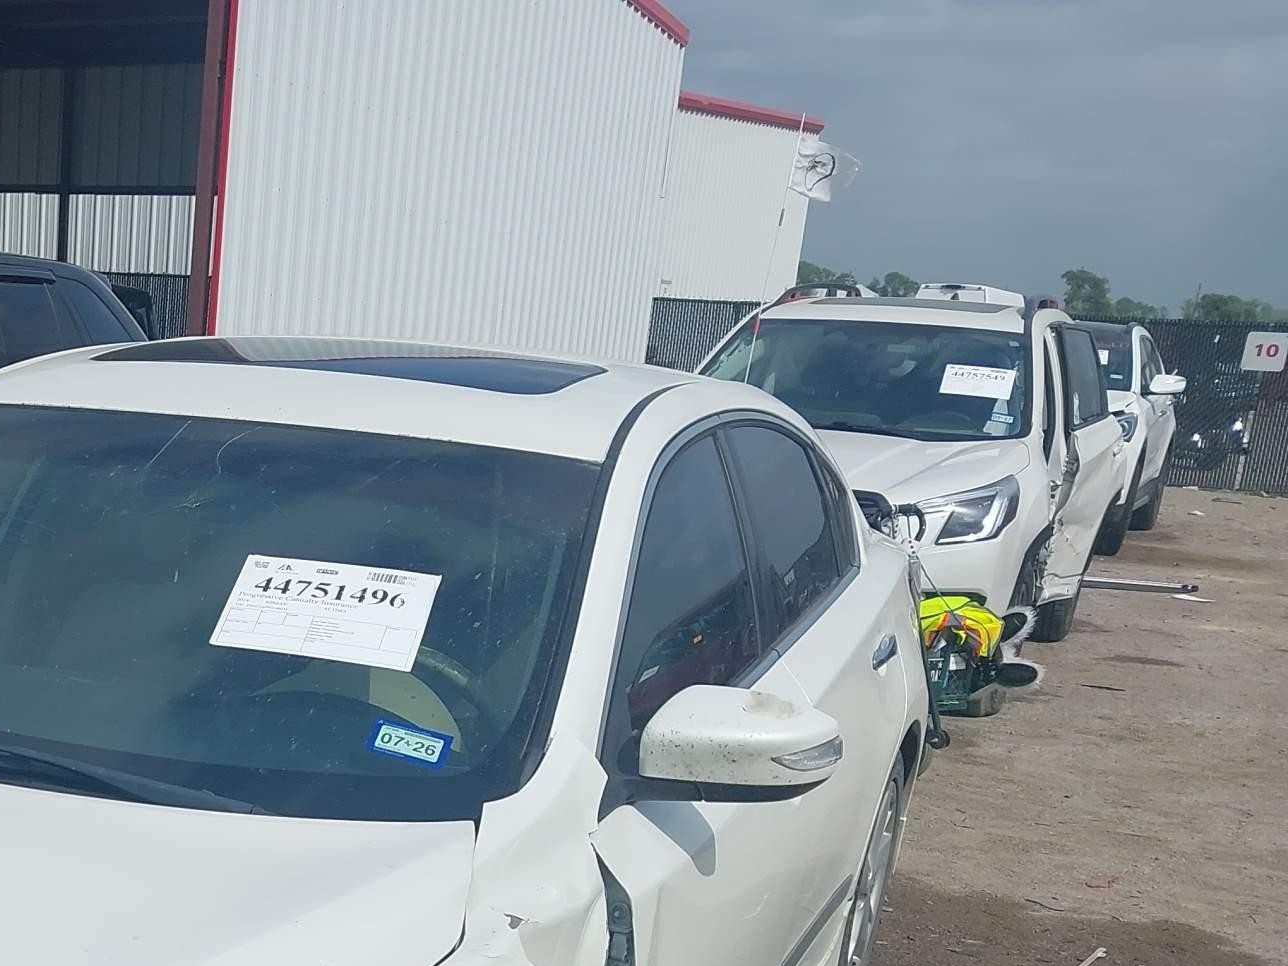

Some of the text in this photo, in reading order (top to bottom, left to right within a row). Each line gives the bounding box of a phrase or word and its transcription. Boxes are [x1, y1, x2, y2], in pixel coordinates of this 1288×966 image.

[1255, 343, 1280, 358] 10
[239, 591, 283, 601] Progressive
[285, 595, 319, 606] Casualty
[254, 576, 407, 609] 44751496
